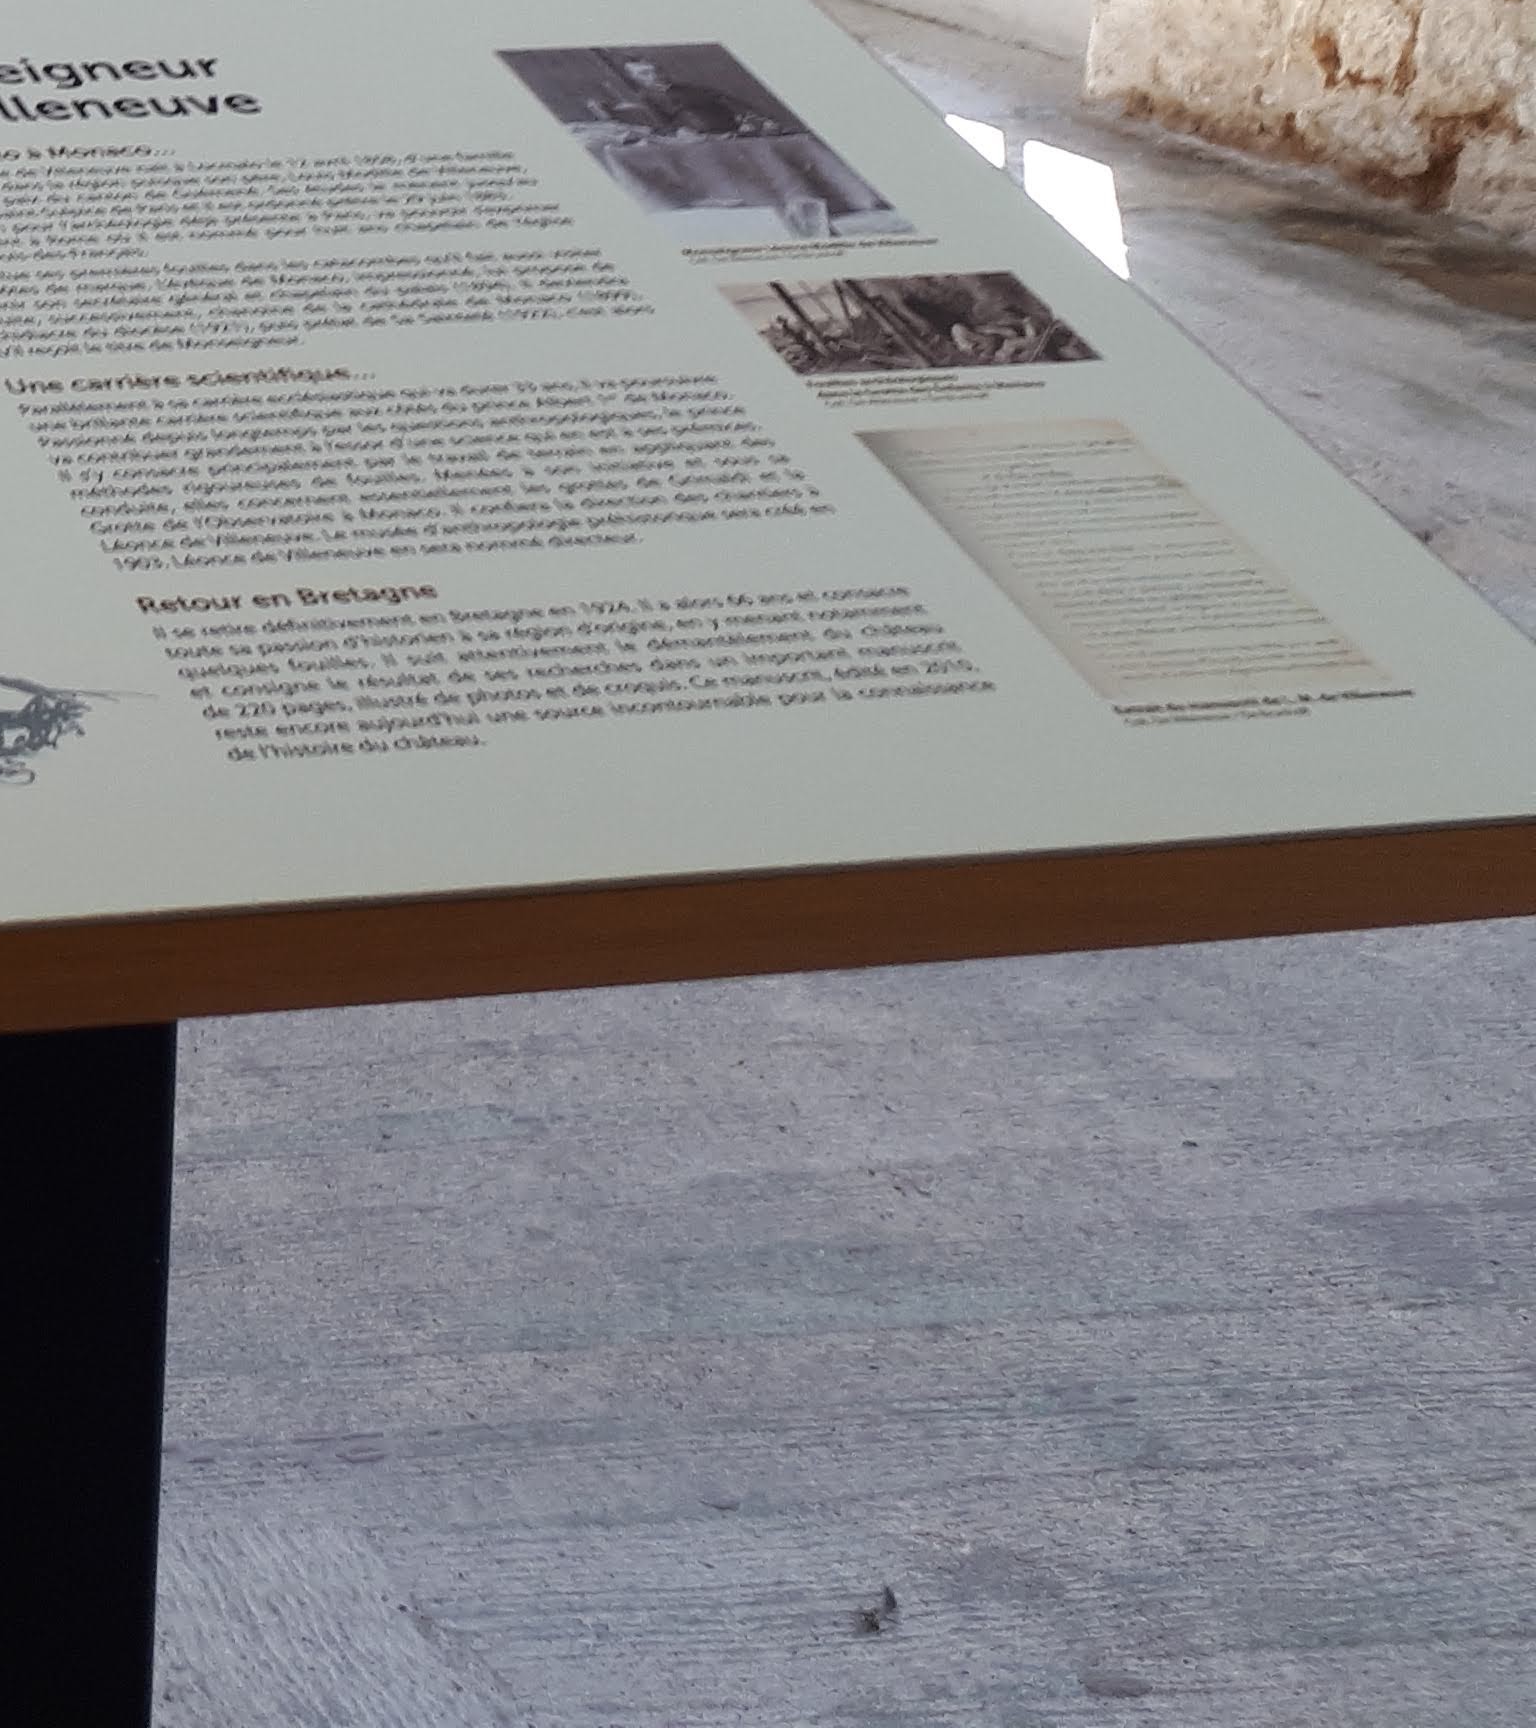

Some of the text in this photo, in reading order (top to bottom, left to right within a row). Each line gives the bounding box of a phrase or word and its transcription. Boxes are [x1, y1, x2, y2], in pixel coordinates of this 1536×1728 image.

[136, 585, 436, 613] Retour en Bretagne
